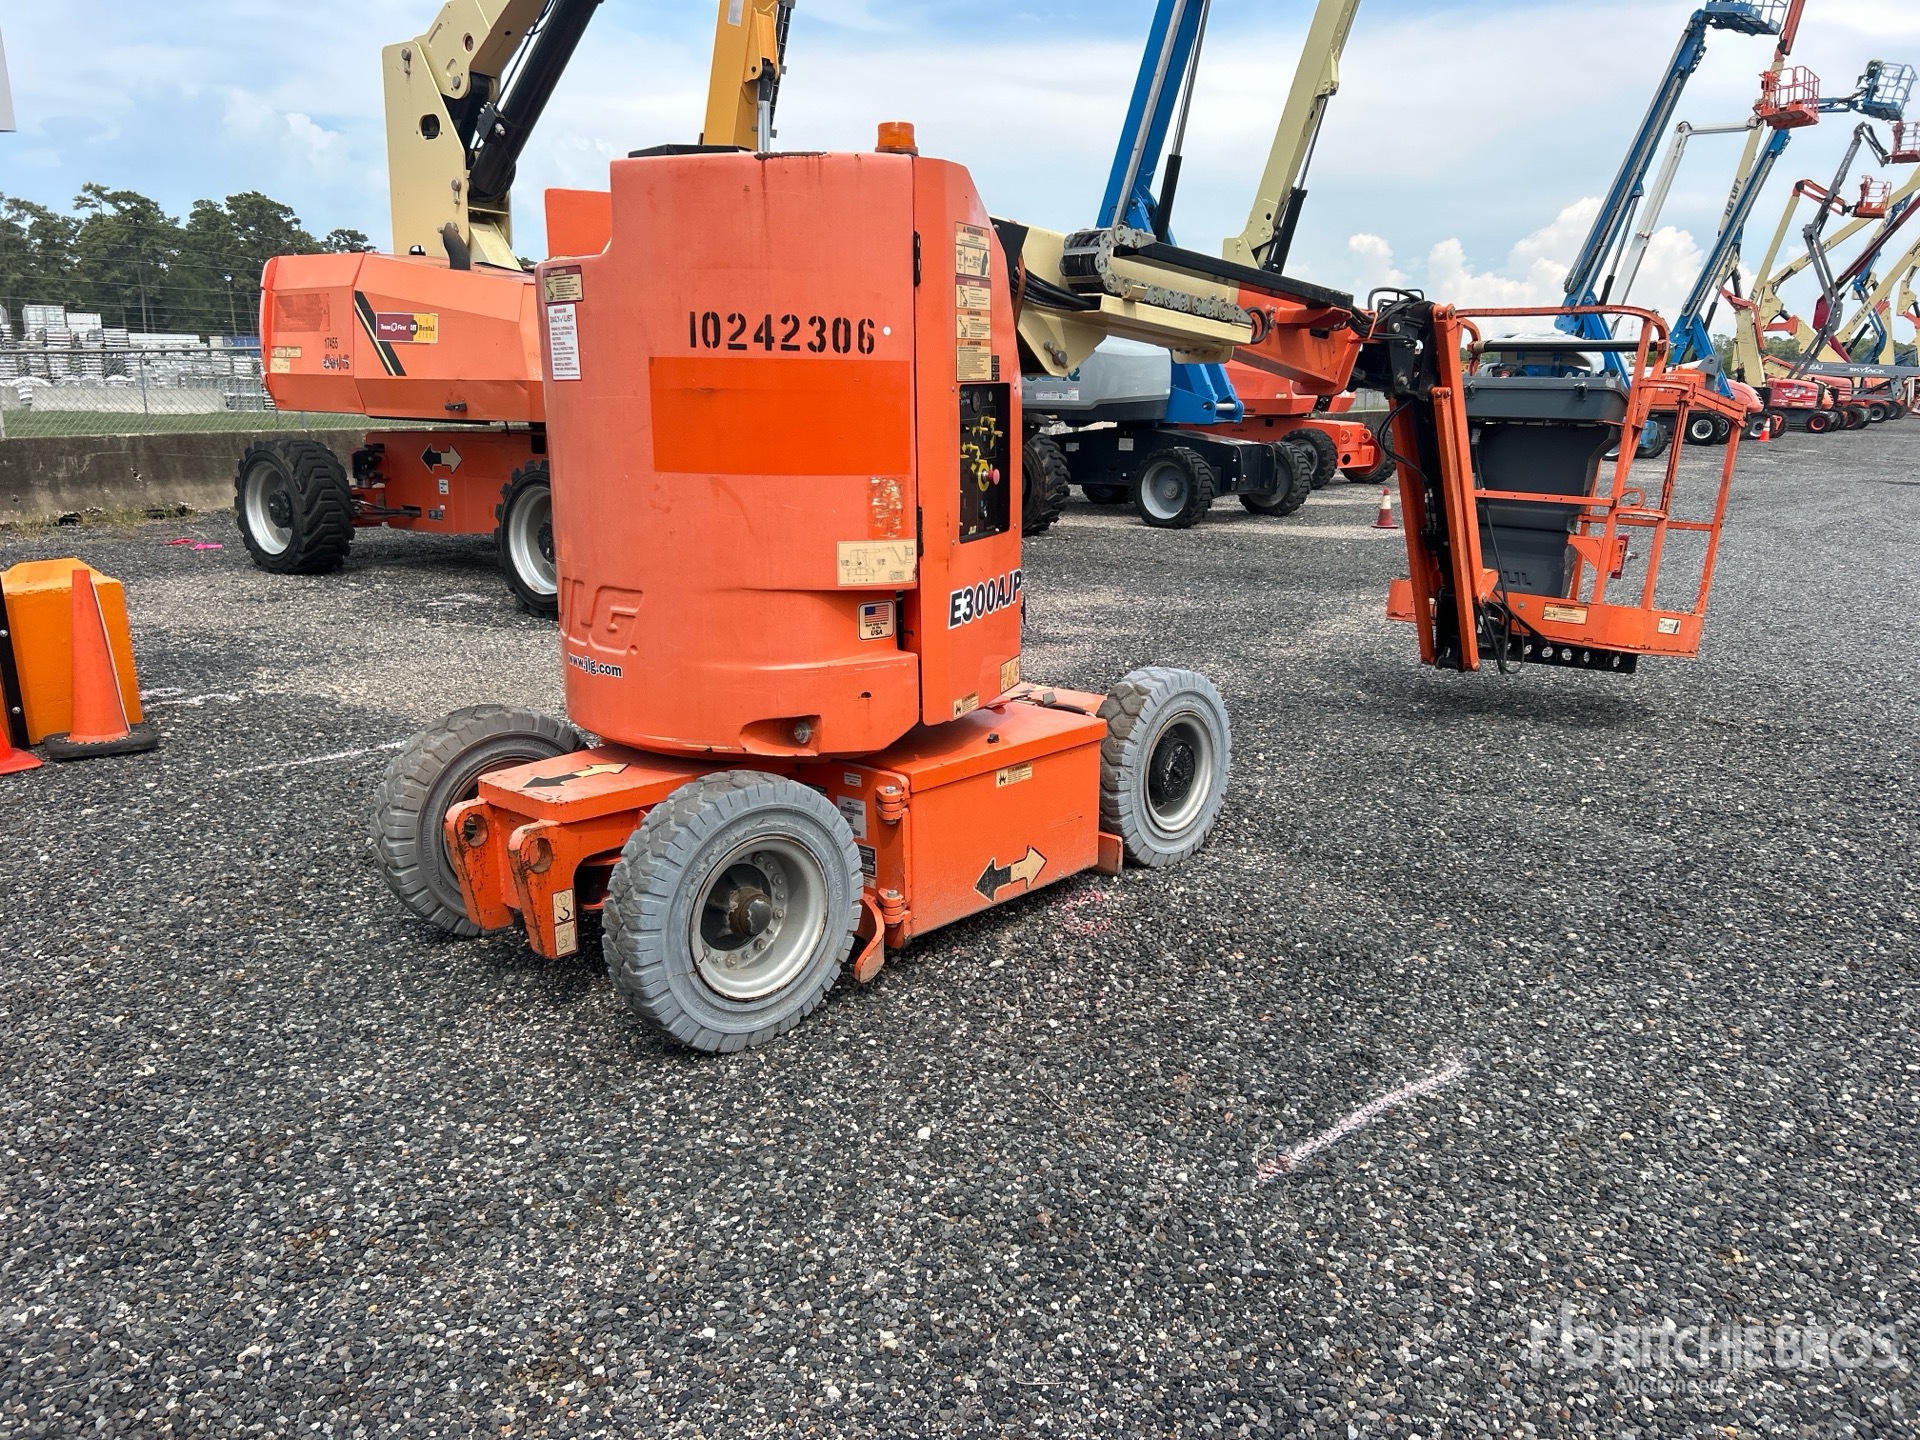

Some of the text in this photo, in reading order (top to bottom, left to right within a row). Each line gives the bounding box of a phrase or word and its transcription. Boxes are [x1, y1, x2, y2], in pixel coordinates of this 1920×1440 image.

[689, 311, 875, 355] 10242306
[1849, 366, 1886, 374] SKYJACK
[948, 568, 1022, 629] E300AJP
[569, 655, 623, 676] www.jlg.com
